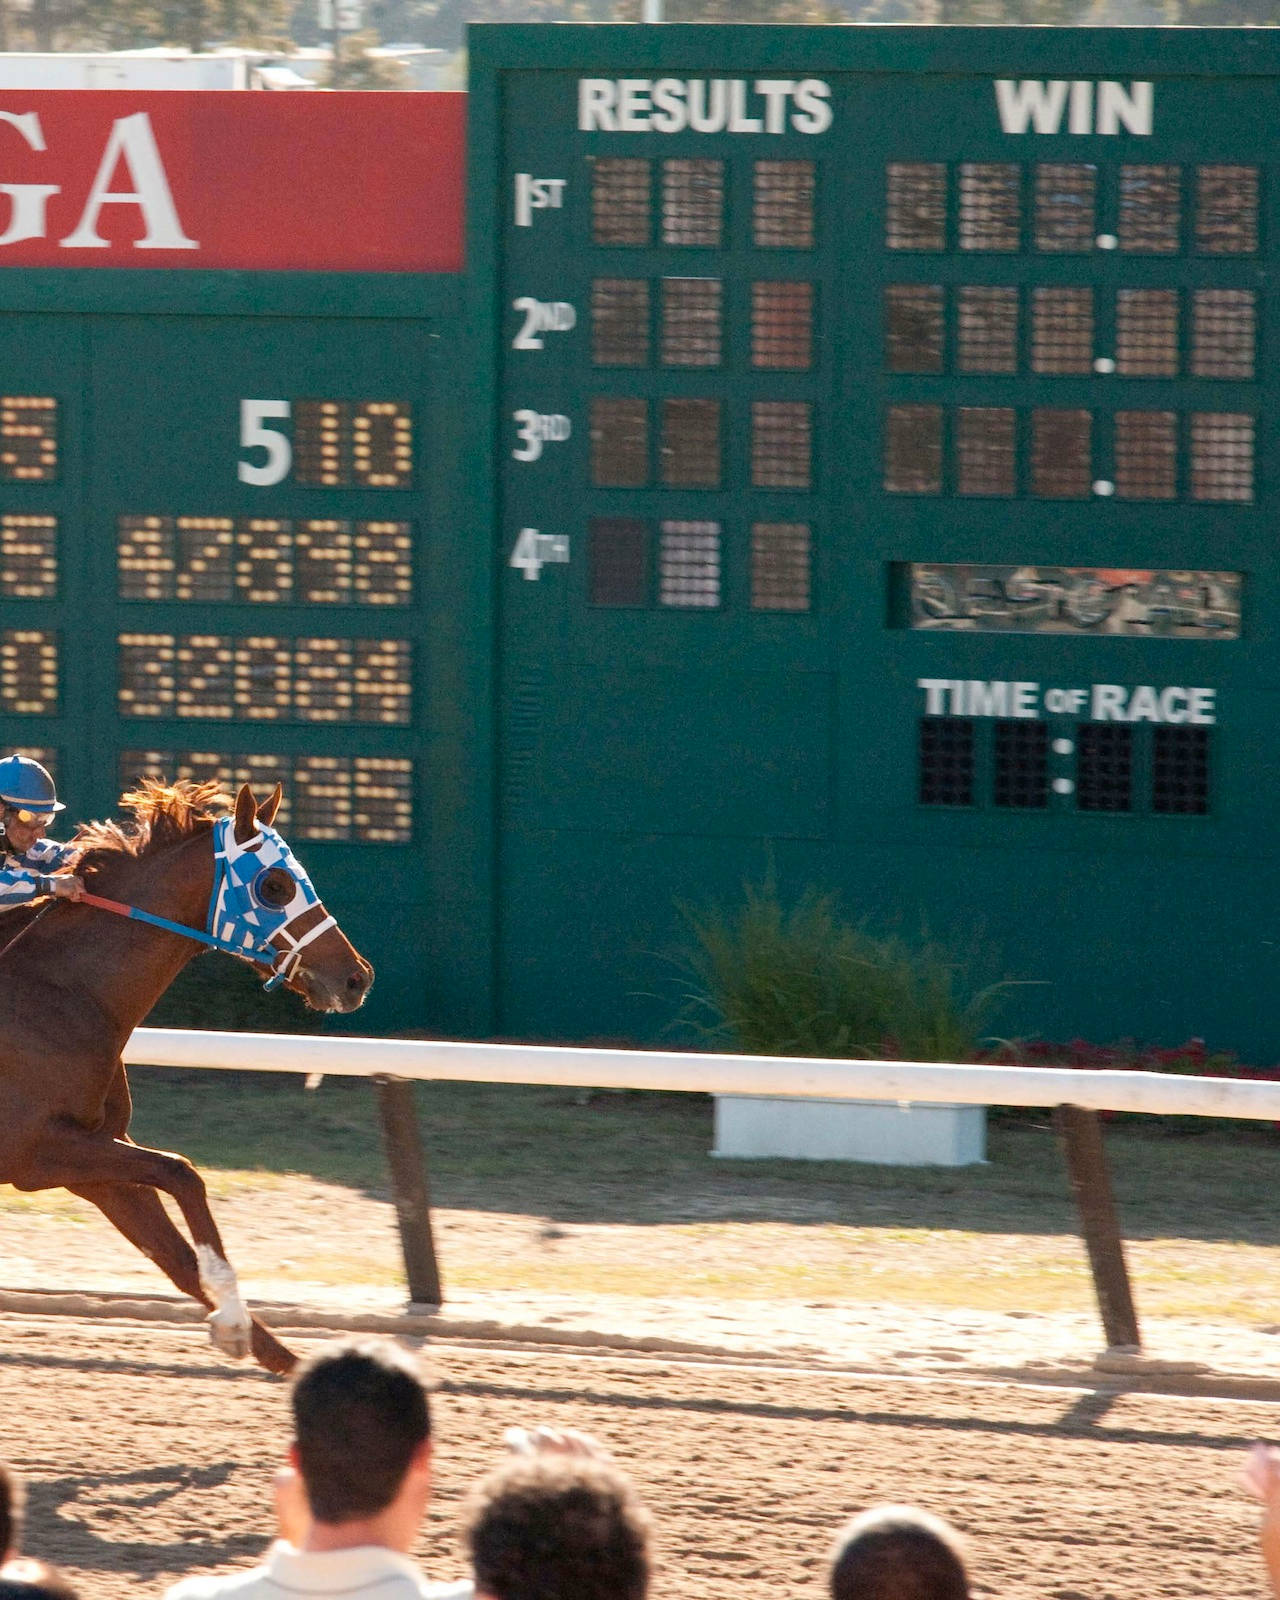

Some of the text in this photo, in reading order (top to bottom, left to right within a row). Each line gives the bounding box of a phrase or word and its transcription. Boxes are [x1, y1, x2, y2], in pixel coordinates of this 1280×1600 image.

[579, 79, 832, 134] RESULTS
[995, 80, 1152, 135] WIN
[514, 297, 578, 349] 2ND
[239, 400, 290, 486] 5
[323, 405, 408, 484] 10
[514, 410, 571, 461] 3RD
[122, 518, 408, 602] 47898
[511, 528, 568, 580] 4TH
[122, 636, 407, 720] 32084
[920, 679, 1213, 723] TIME OF RACE
